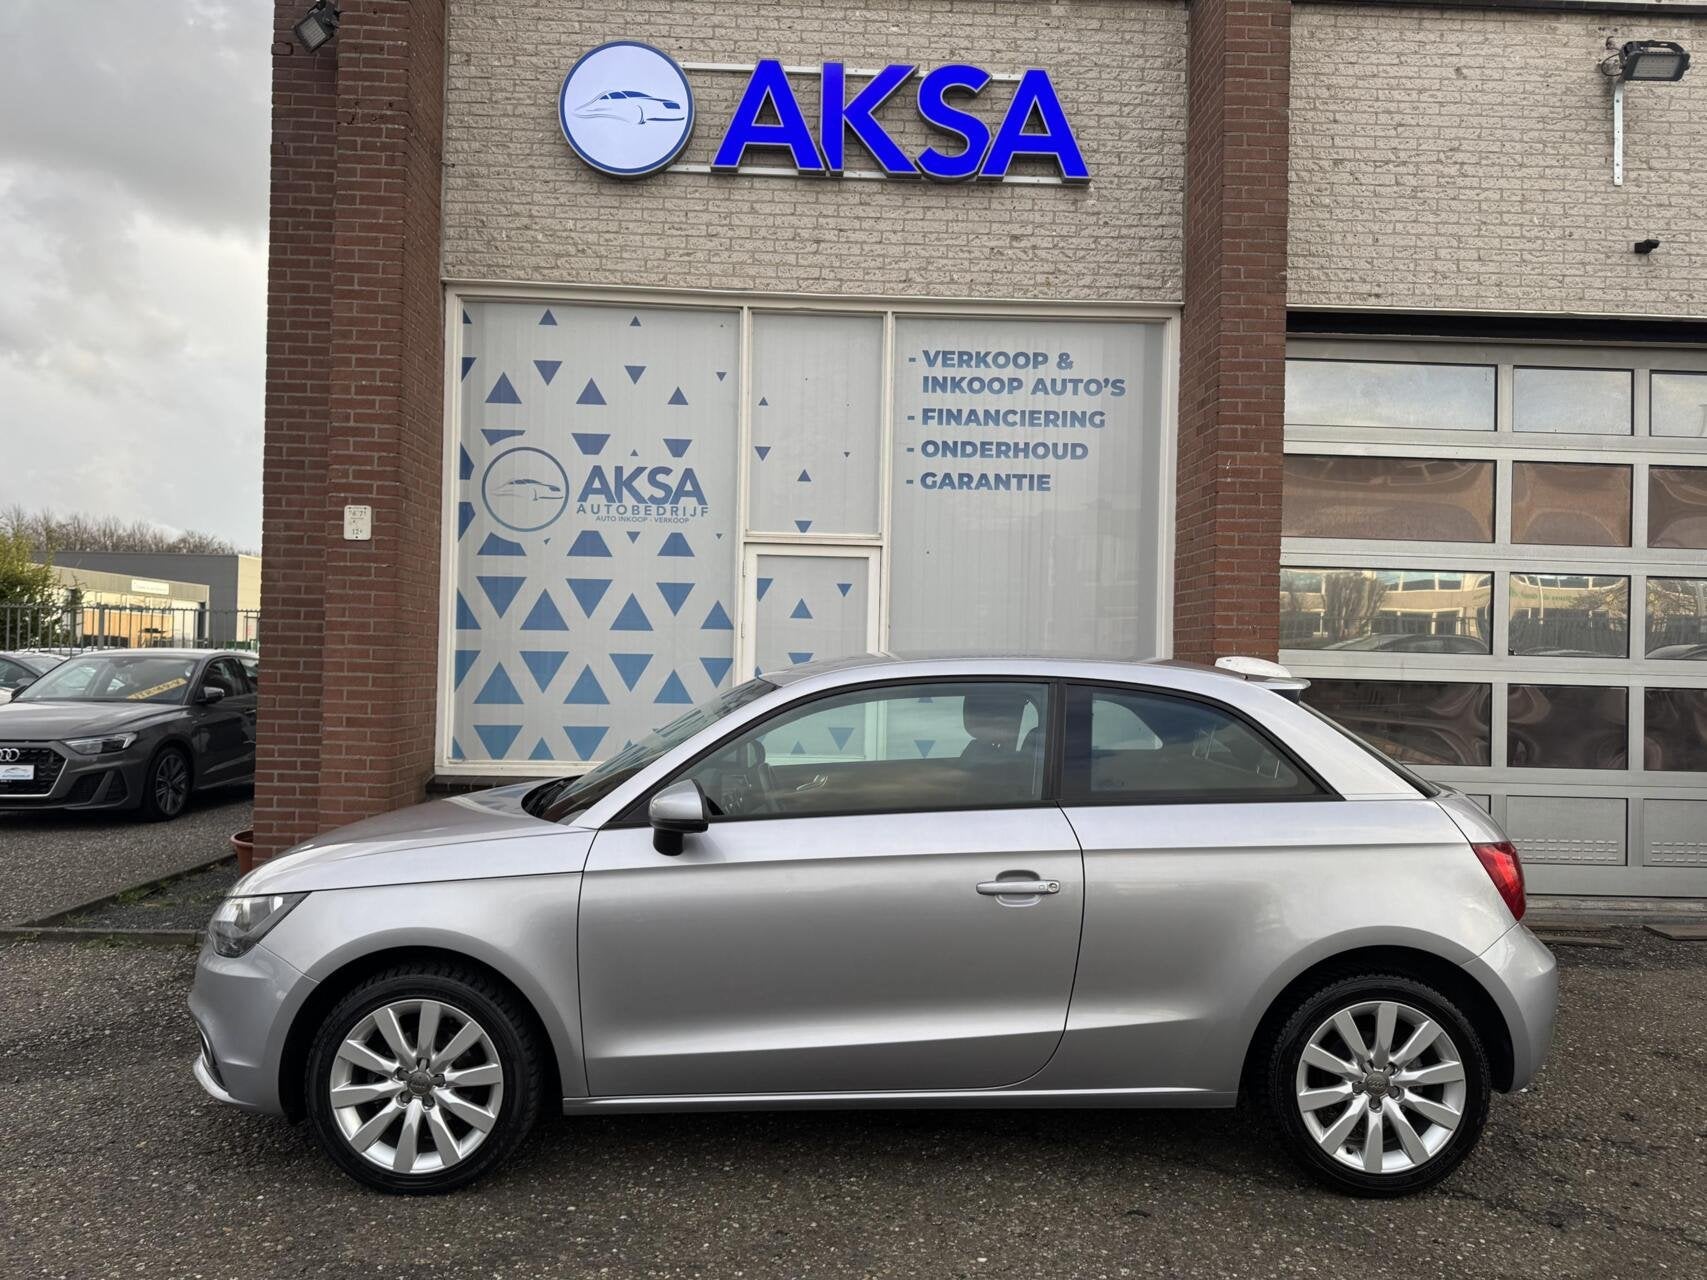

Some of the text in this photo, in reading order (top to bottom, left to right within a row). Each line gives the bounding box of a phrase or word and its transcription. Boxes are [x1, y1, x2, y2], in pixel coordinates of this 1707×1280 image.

[711, 58, 1091, 183] AKSA
[922, 349, 1049, 370] VERKOOP
[1056, 352, 1074, 370] &
[922, 375, 1127, 397] INKOOP AUTO'S
[921, 407, 1106, 429] FINANCIERING
[920, 439, 1089, 460] ONDERHOUD
[577, 464, 708, 506] AKSA
[920, 471, 1051, 492] GARANTIE
[576, 503, 709, 518] AUTOBEDRIJF
[595, 515, 617, 523] AUTO
[619, 516, 648, 524] INKOOP
[654, 517, 690, 525] VERKOOP
